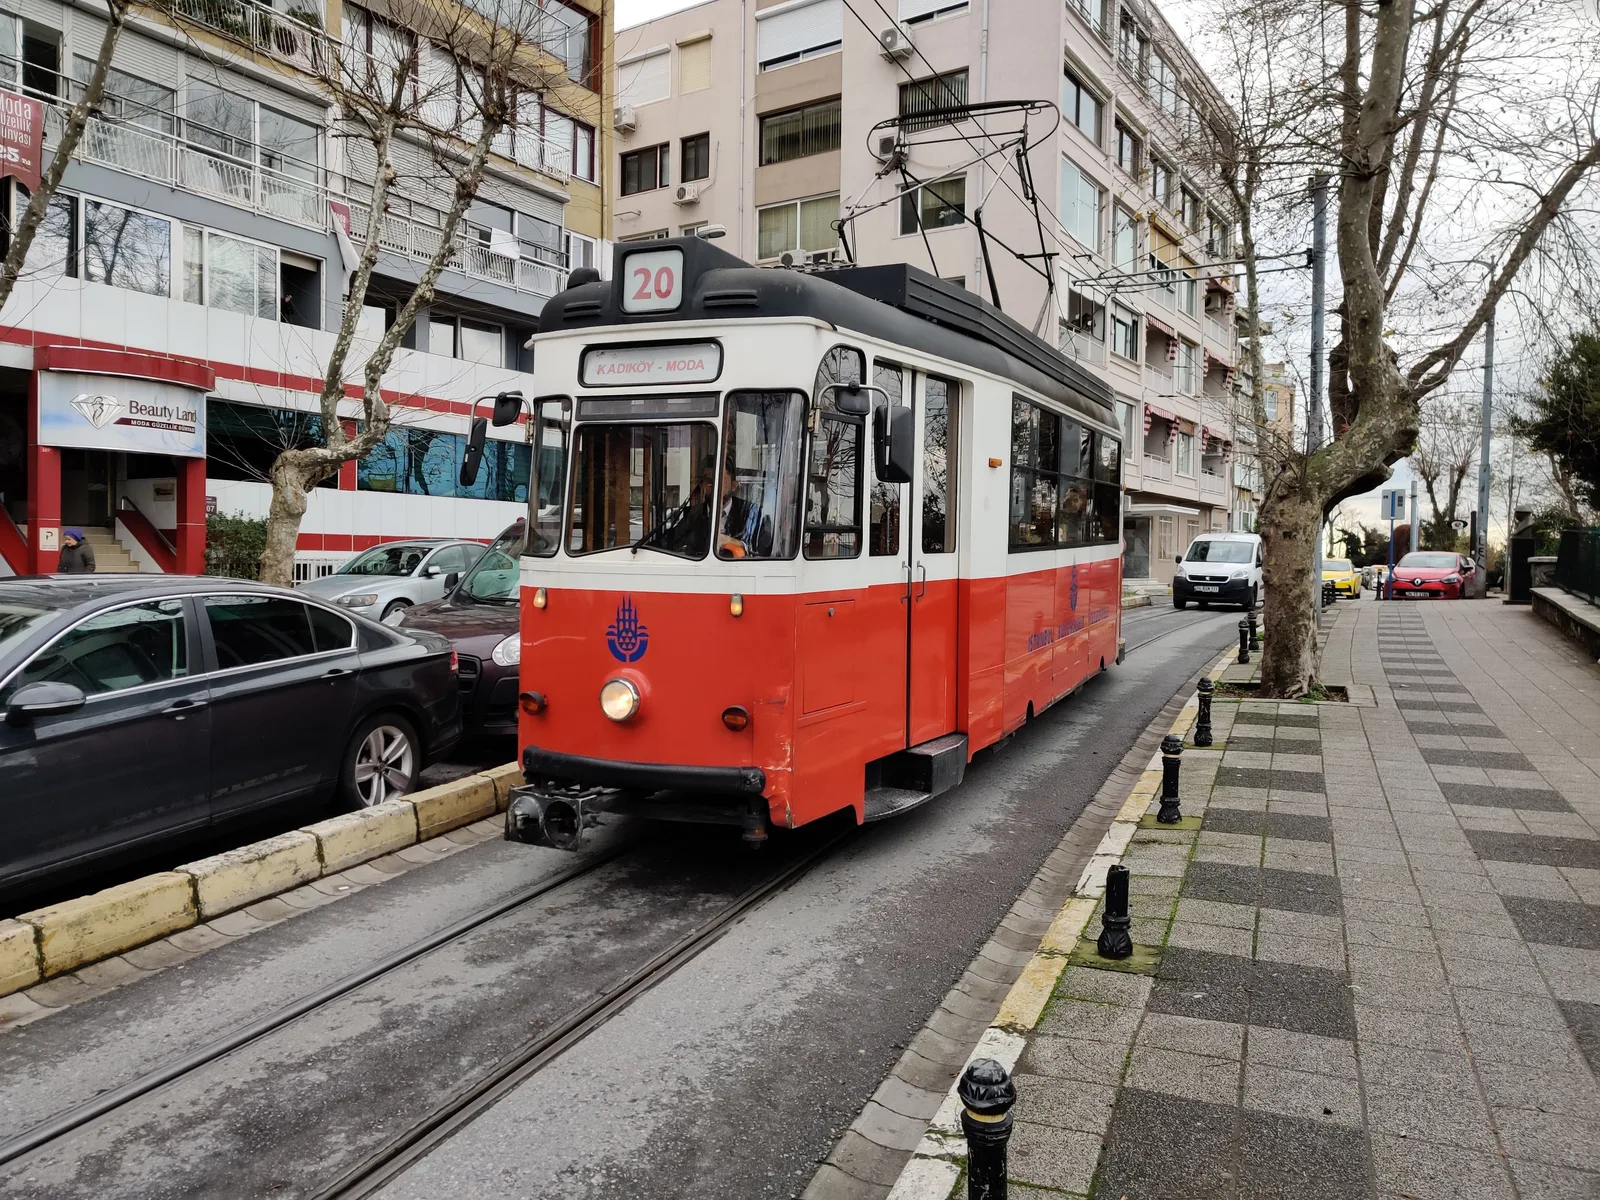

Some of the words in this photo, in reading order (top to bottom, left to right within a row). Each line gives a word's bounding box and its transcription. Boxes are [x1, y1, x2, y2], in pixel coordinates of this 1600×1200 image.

[0, 111, 31, 133] üzellik
[0, 125, 31, 146] ünyası
[632, 266, 675, 300] 20
[597, 360, 655, 375] KADIKÖY
[666, 359, 705, 372] MODA
[129, 400, 174, 421] Beauty
[176, 406, 197, 423] Land
[130, 419, 150, 427] MODA
